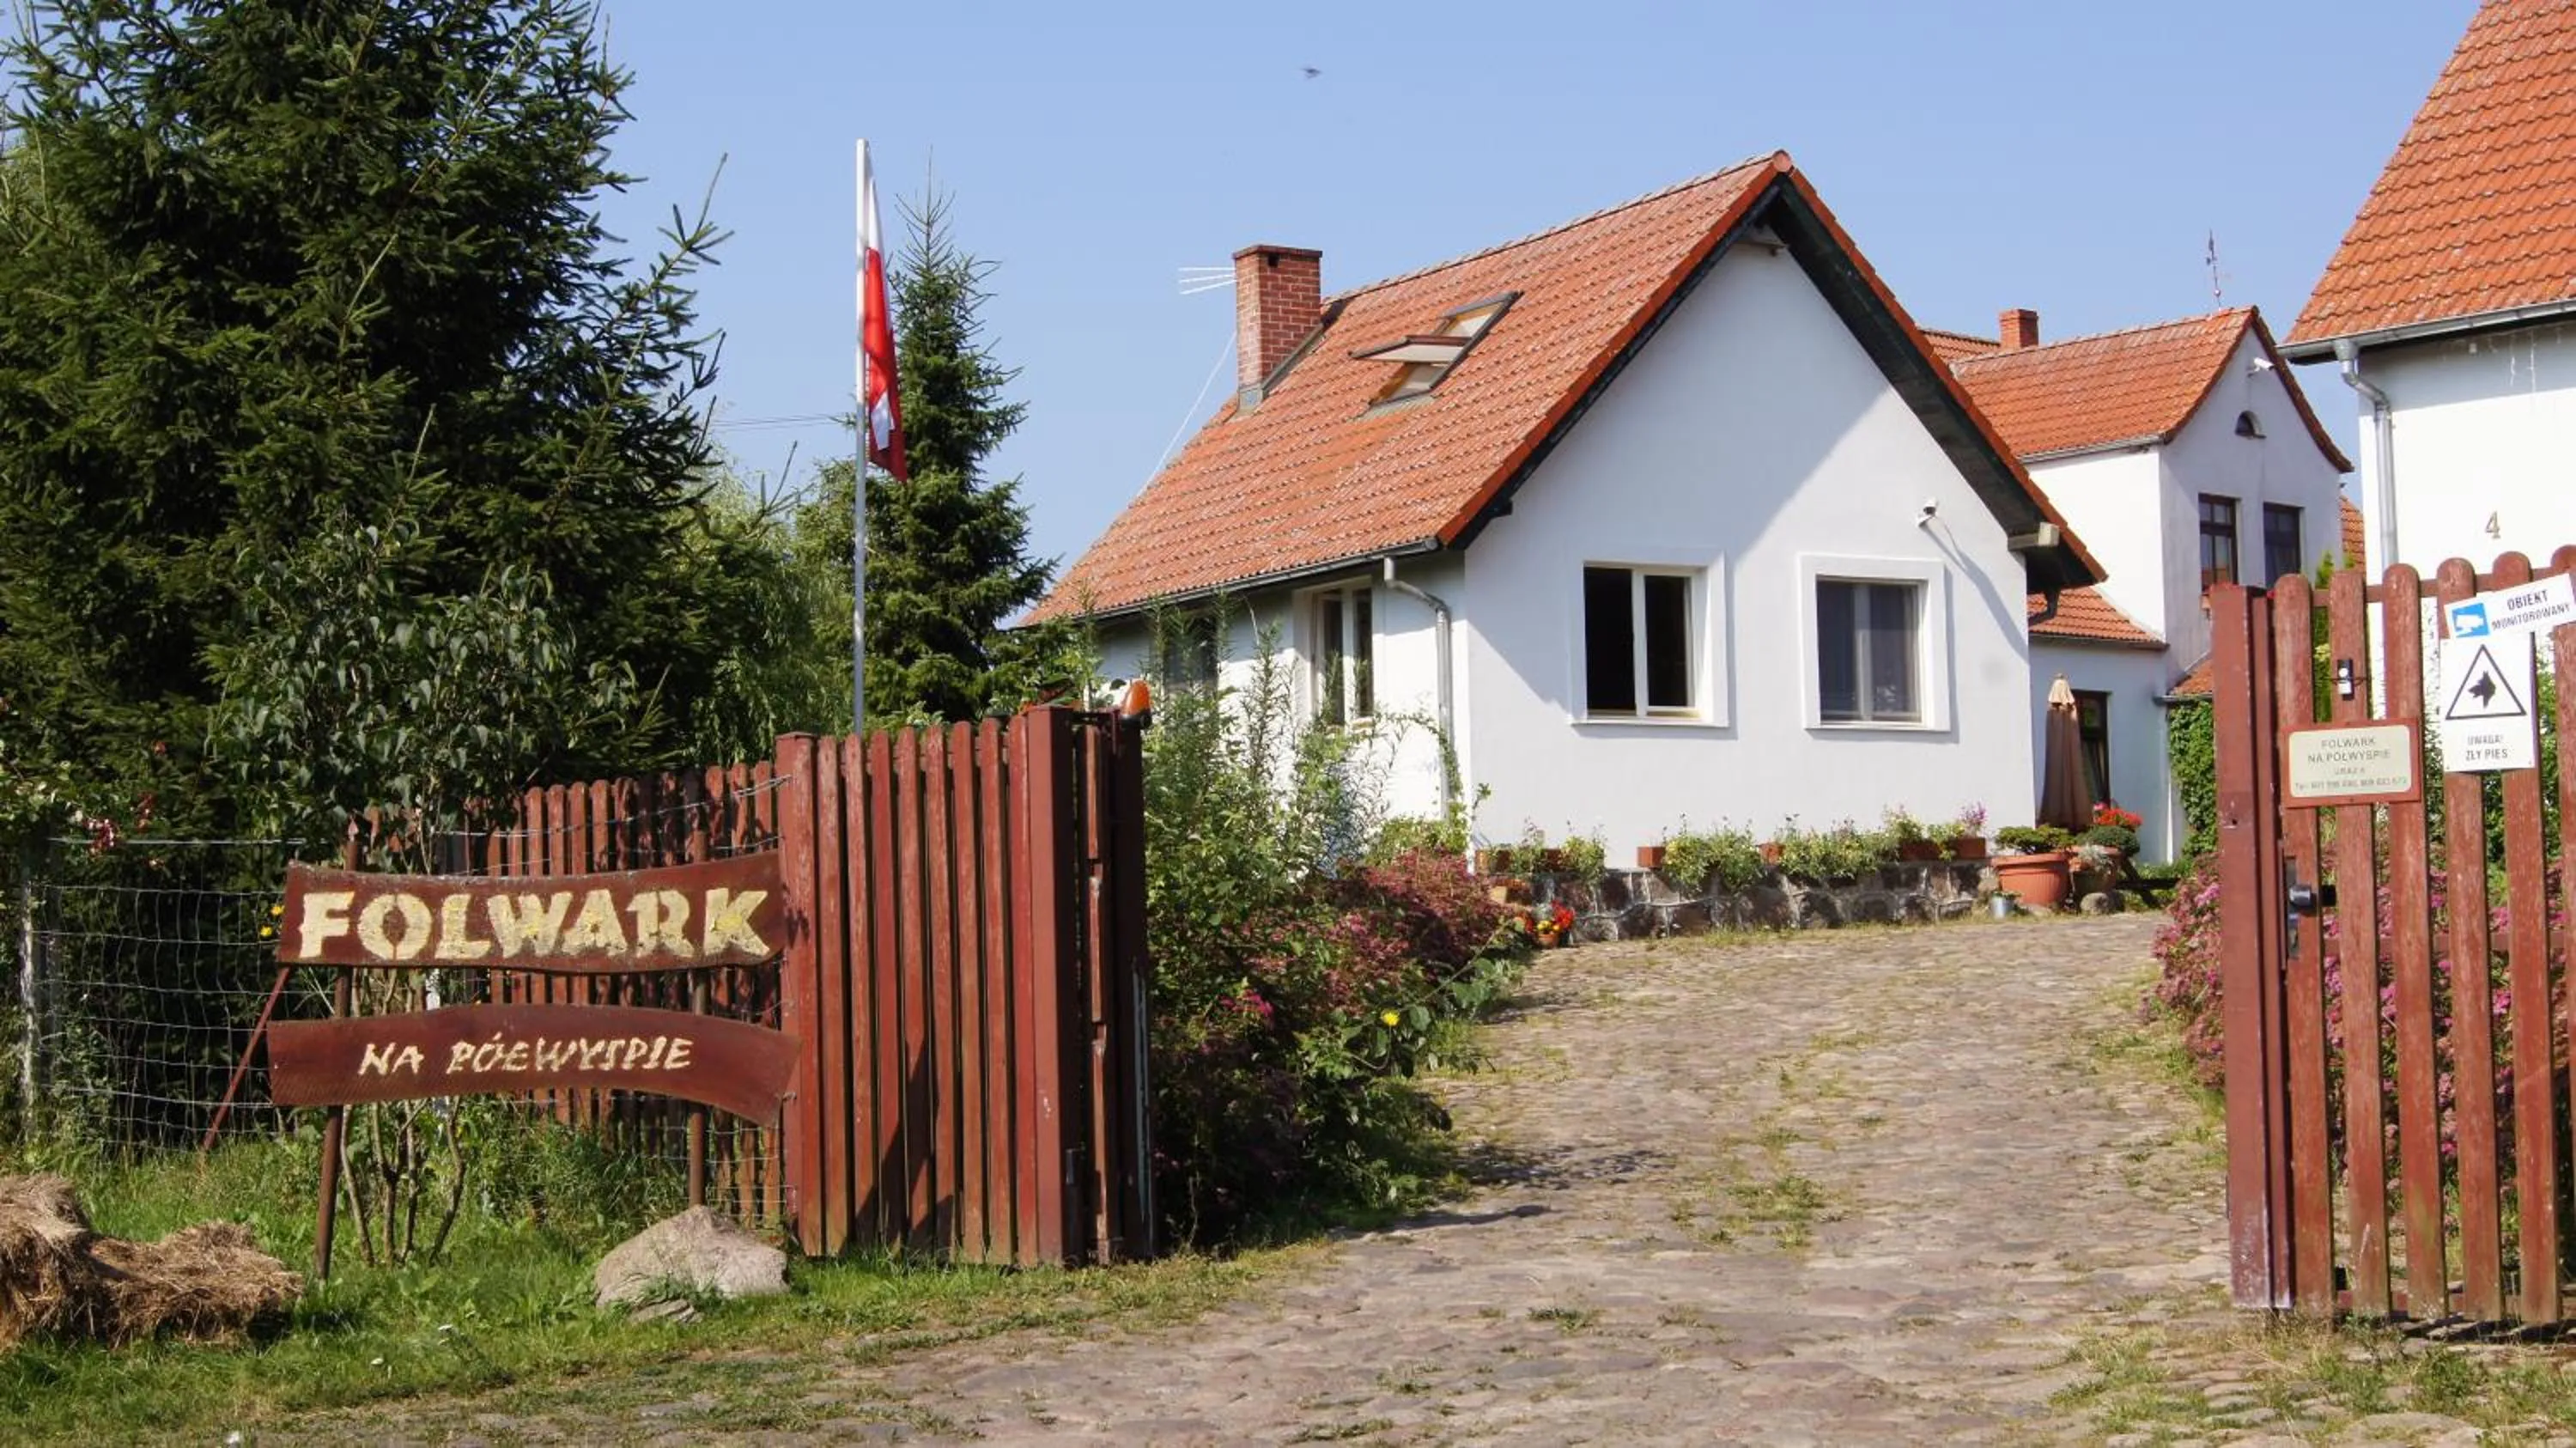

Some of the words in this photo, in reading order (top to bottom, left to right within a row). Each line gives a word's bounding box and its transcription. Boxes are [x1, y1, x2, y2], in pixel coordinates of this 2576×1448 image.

[2485, 511, 2500, 539] 4
[2507, 589, 2549, 611] OBIEKT
[2491, 603, 2570, 630] MONITOROWANY
[2321, 736, 2376, 749] FOLWARK
[2484, 748, 2508, 760] PIES
[2307, 754, 2323, 764] NA
[299, 887, 771, 959] FOLWARK
[357, 1041, 425, 1075] NA
